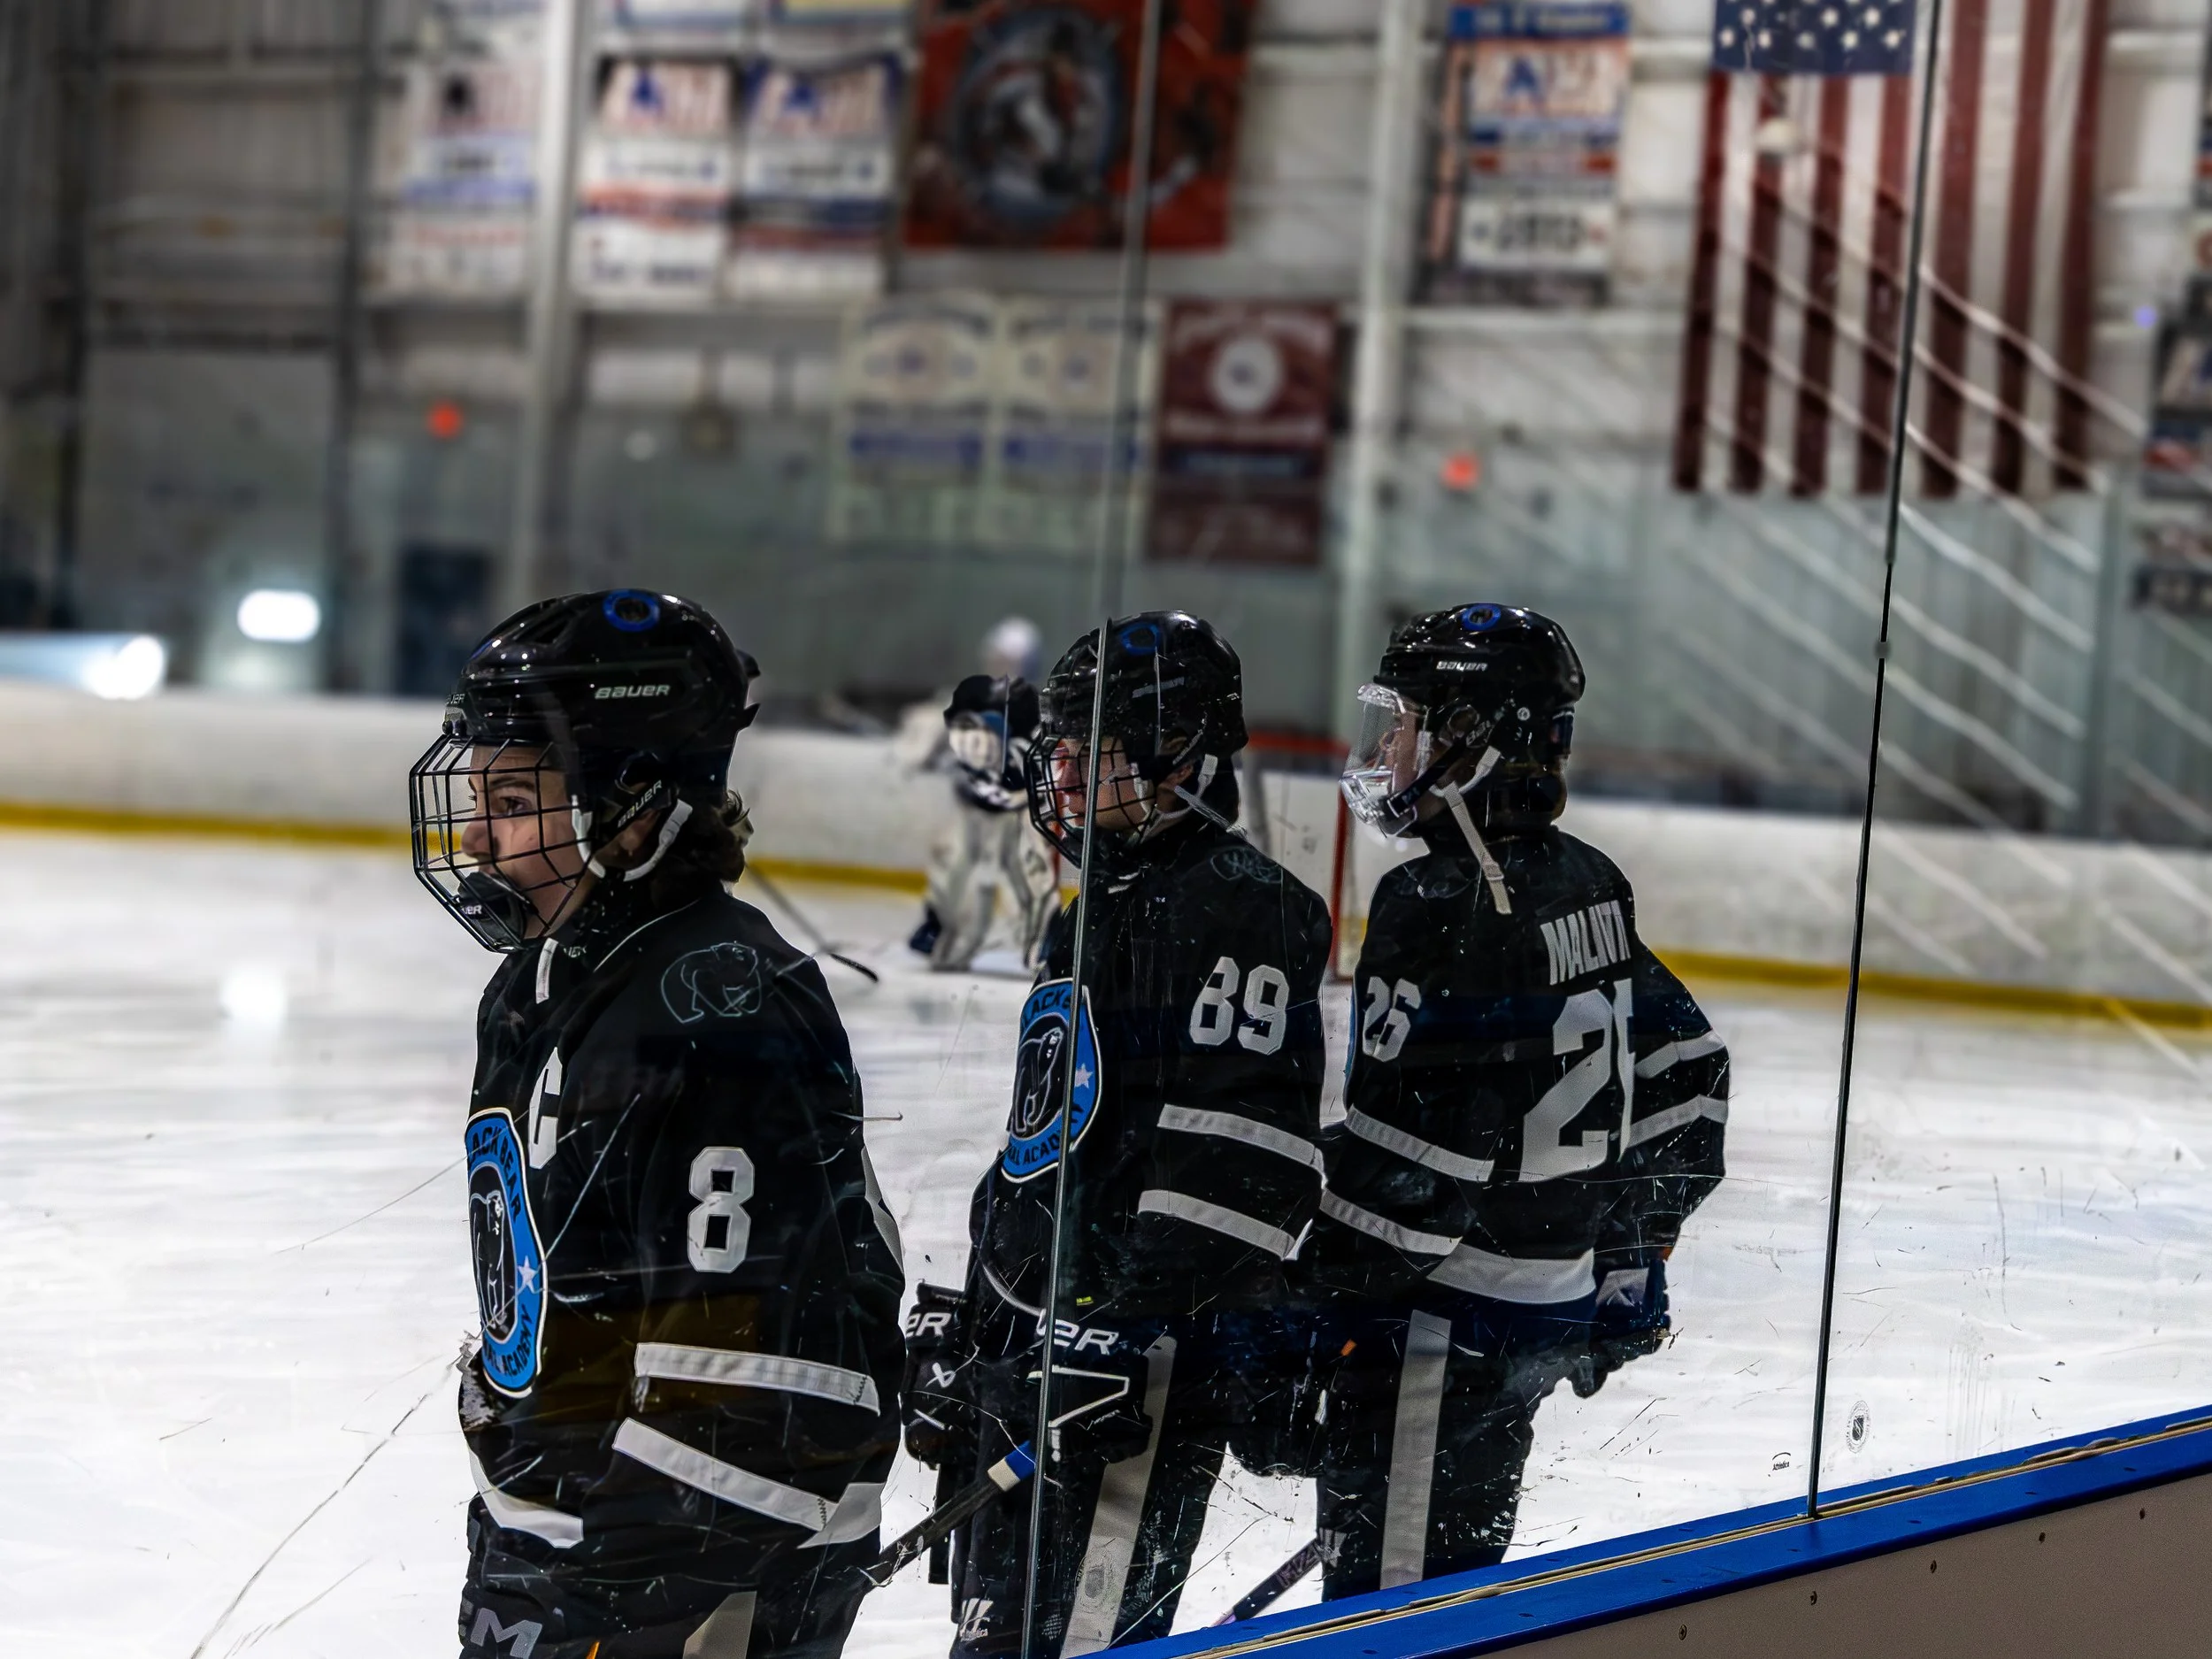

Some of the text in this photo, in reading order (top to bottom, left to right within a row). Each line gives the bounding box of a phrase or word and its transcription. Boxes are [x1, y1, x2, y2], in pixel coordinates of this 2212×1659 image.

[595, 684, 671, 699] BAUER
[1436, 661, 1488, 672] BAUER
[618, 780, 662, 828] BAUER
[1189, 956, 1290, 1056] 89
[1363, 976, 1422, 1063] 26
[498, 1137, 521, 1223] BEAR
[687, 1147, 755, 1273] 8
